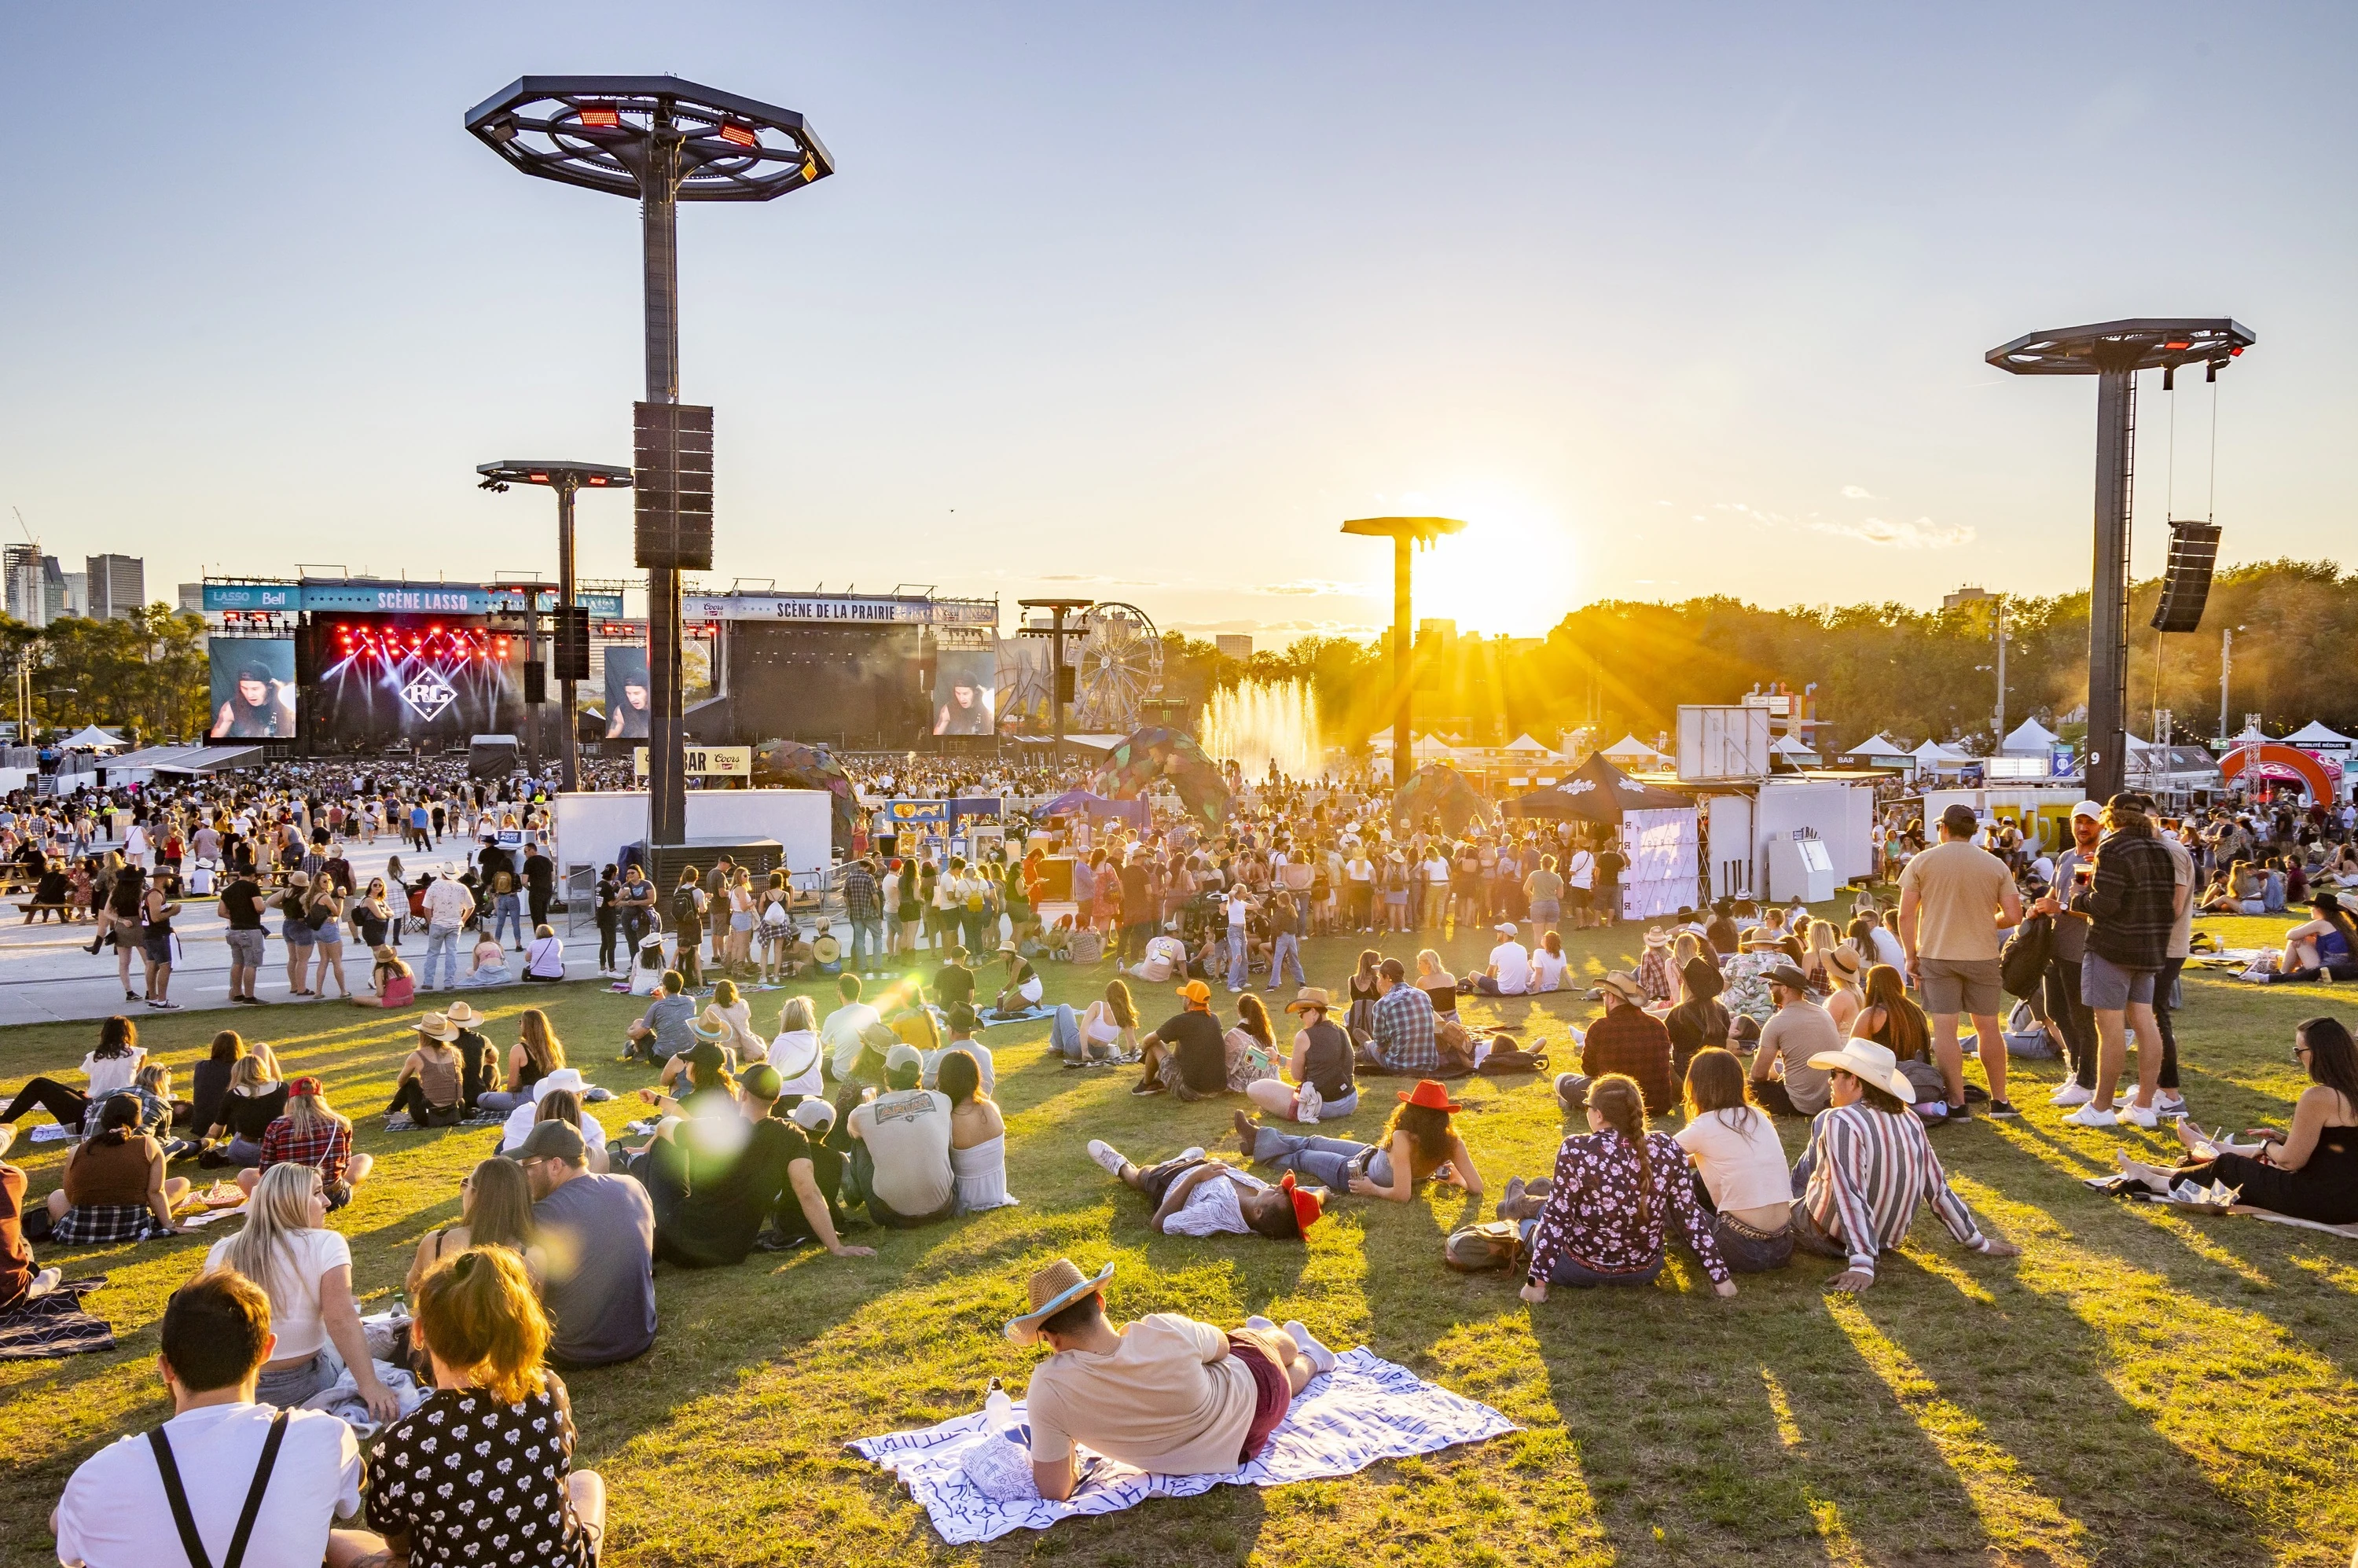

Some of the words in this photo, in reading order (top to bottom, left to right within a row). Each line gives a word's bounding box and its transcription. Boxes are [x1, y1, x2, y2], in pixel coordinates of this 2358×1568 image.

[213, 591, 250, 601] LASSO
[262, 592, 285, 605] Bell
[378, 589, 421, 609] SCÈNE
[424, 593, 468, 611] LASSO
[777, 600, 812, 618] SCÈNE
[817, 604, 829, 618] DE
[834, 604, 847, 619] LA
[851, 604, 895, 620] PRAIRIE
[714, 753, 740, 763] Coors
[2091, 751, 2100, 765] 9
[880, 1100, 929, 1118] ARIAT
